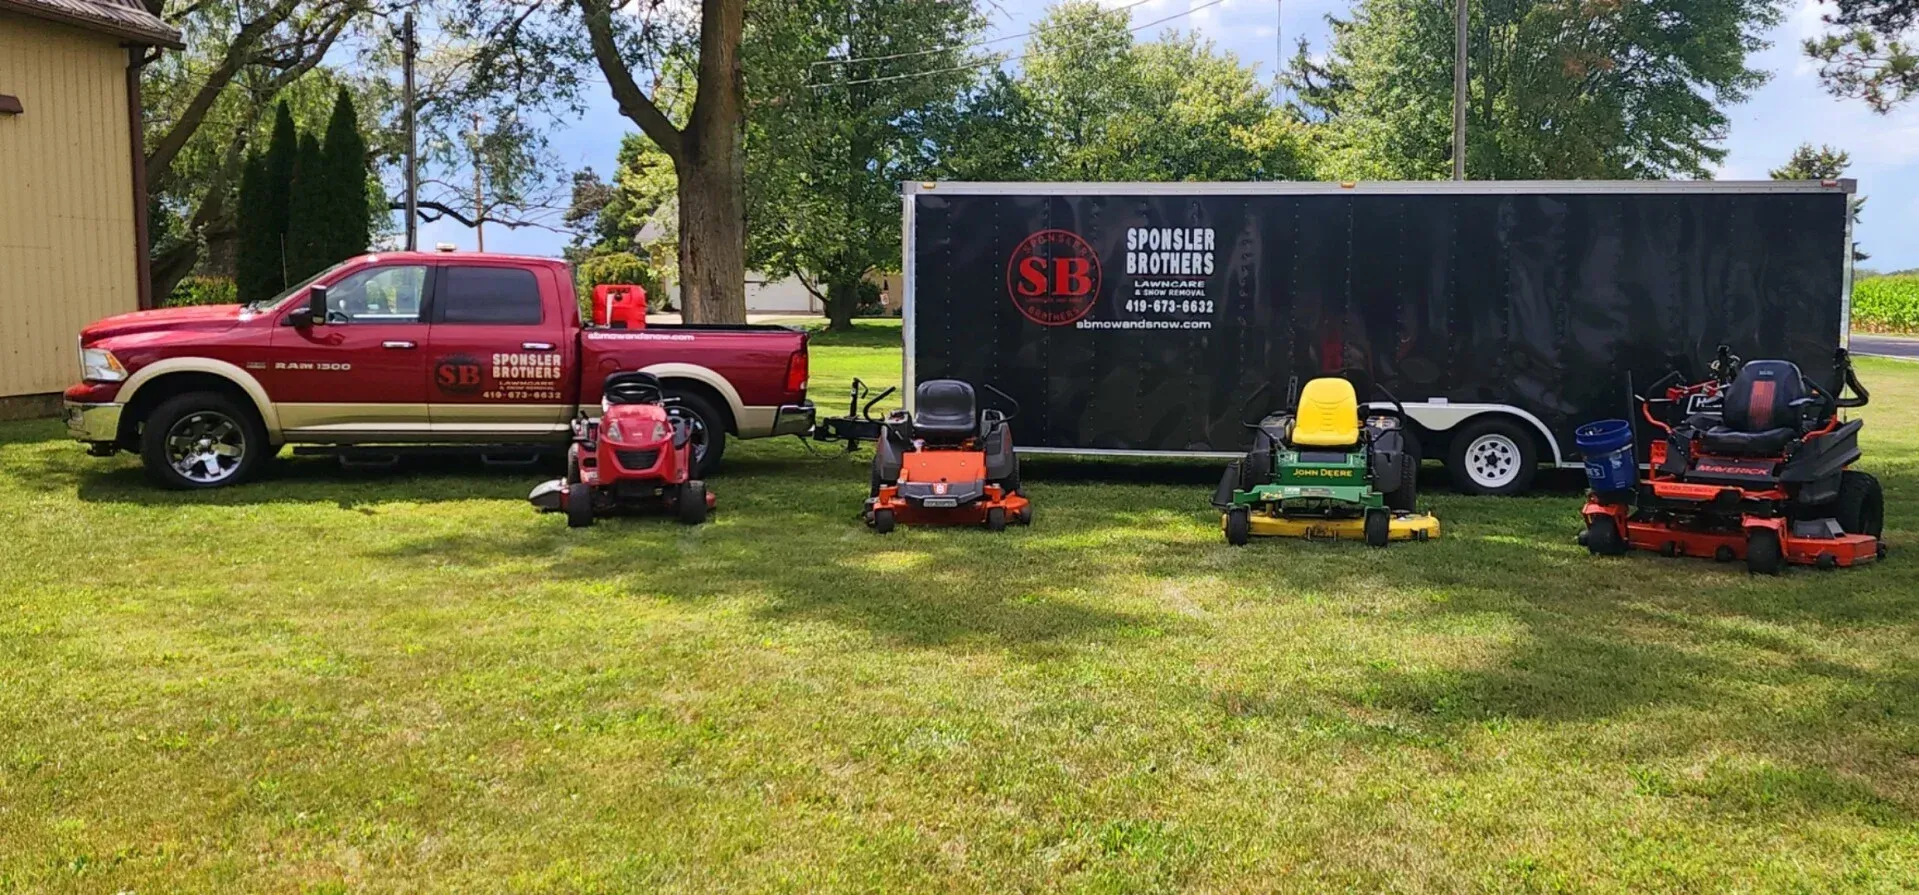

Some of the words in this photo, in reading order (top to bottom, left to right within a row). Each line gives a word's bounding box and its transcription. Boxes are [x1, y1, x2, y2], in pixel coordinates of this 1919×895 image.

[1127, 228, 1214, 251] SPONSLER
[1127, 252, 1214, 275] BROTHERS
[1017, 257, 1092, 296] SB
[1134, 280, 1205, 289] LAWNCARE
[1134, 289, 1141, 297] &
[1143, 289, 1166, 297] SNOW
[1168, 289, 1205, 297] REMOVAL
[1125, 300, 1213, 313] 419-673-6632
[1076, 319, 1211, 329] sbmowandsnow.com
[492, 353, 561, 366] SPONSLER
[275, 362, 313, 370] RAM
[439, 364, 480, 385] SB
[492, 366, 561, 379] BROTHERS
[483, 391, 561, 399] 419-673-6632
[1293, 468, 1318, 476] JOHN
[1320, 469, 1353, 477] DEERE
[1696, 464, 1769, 475] MAVERICK
